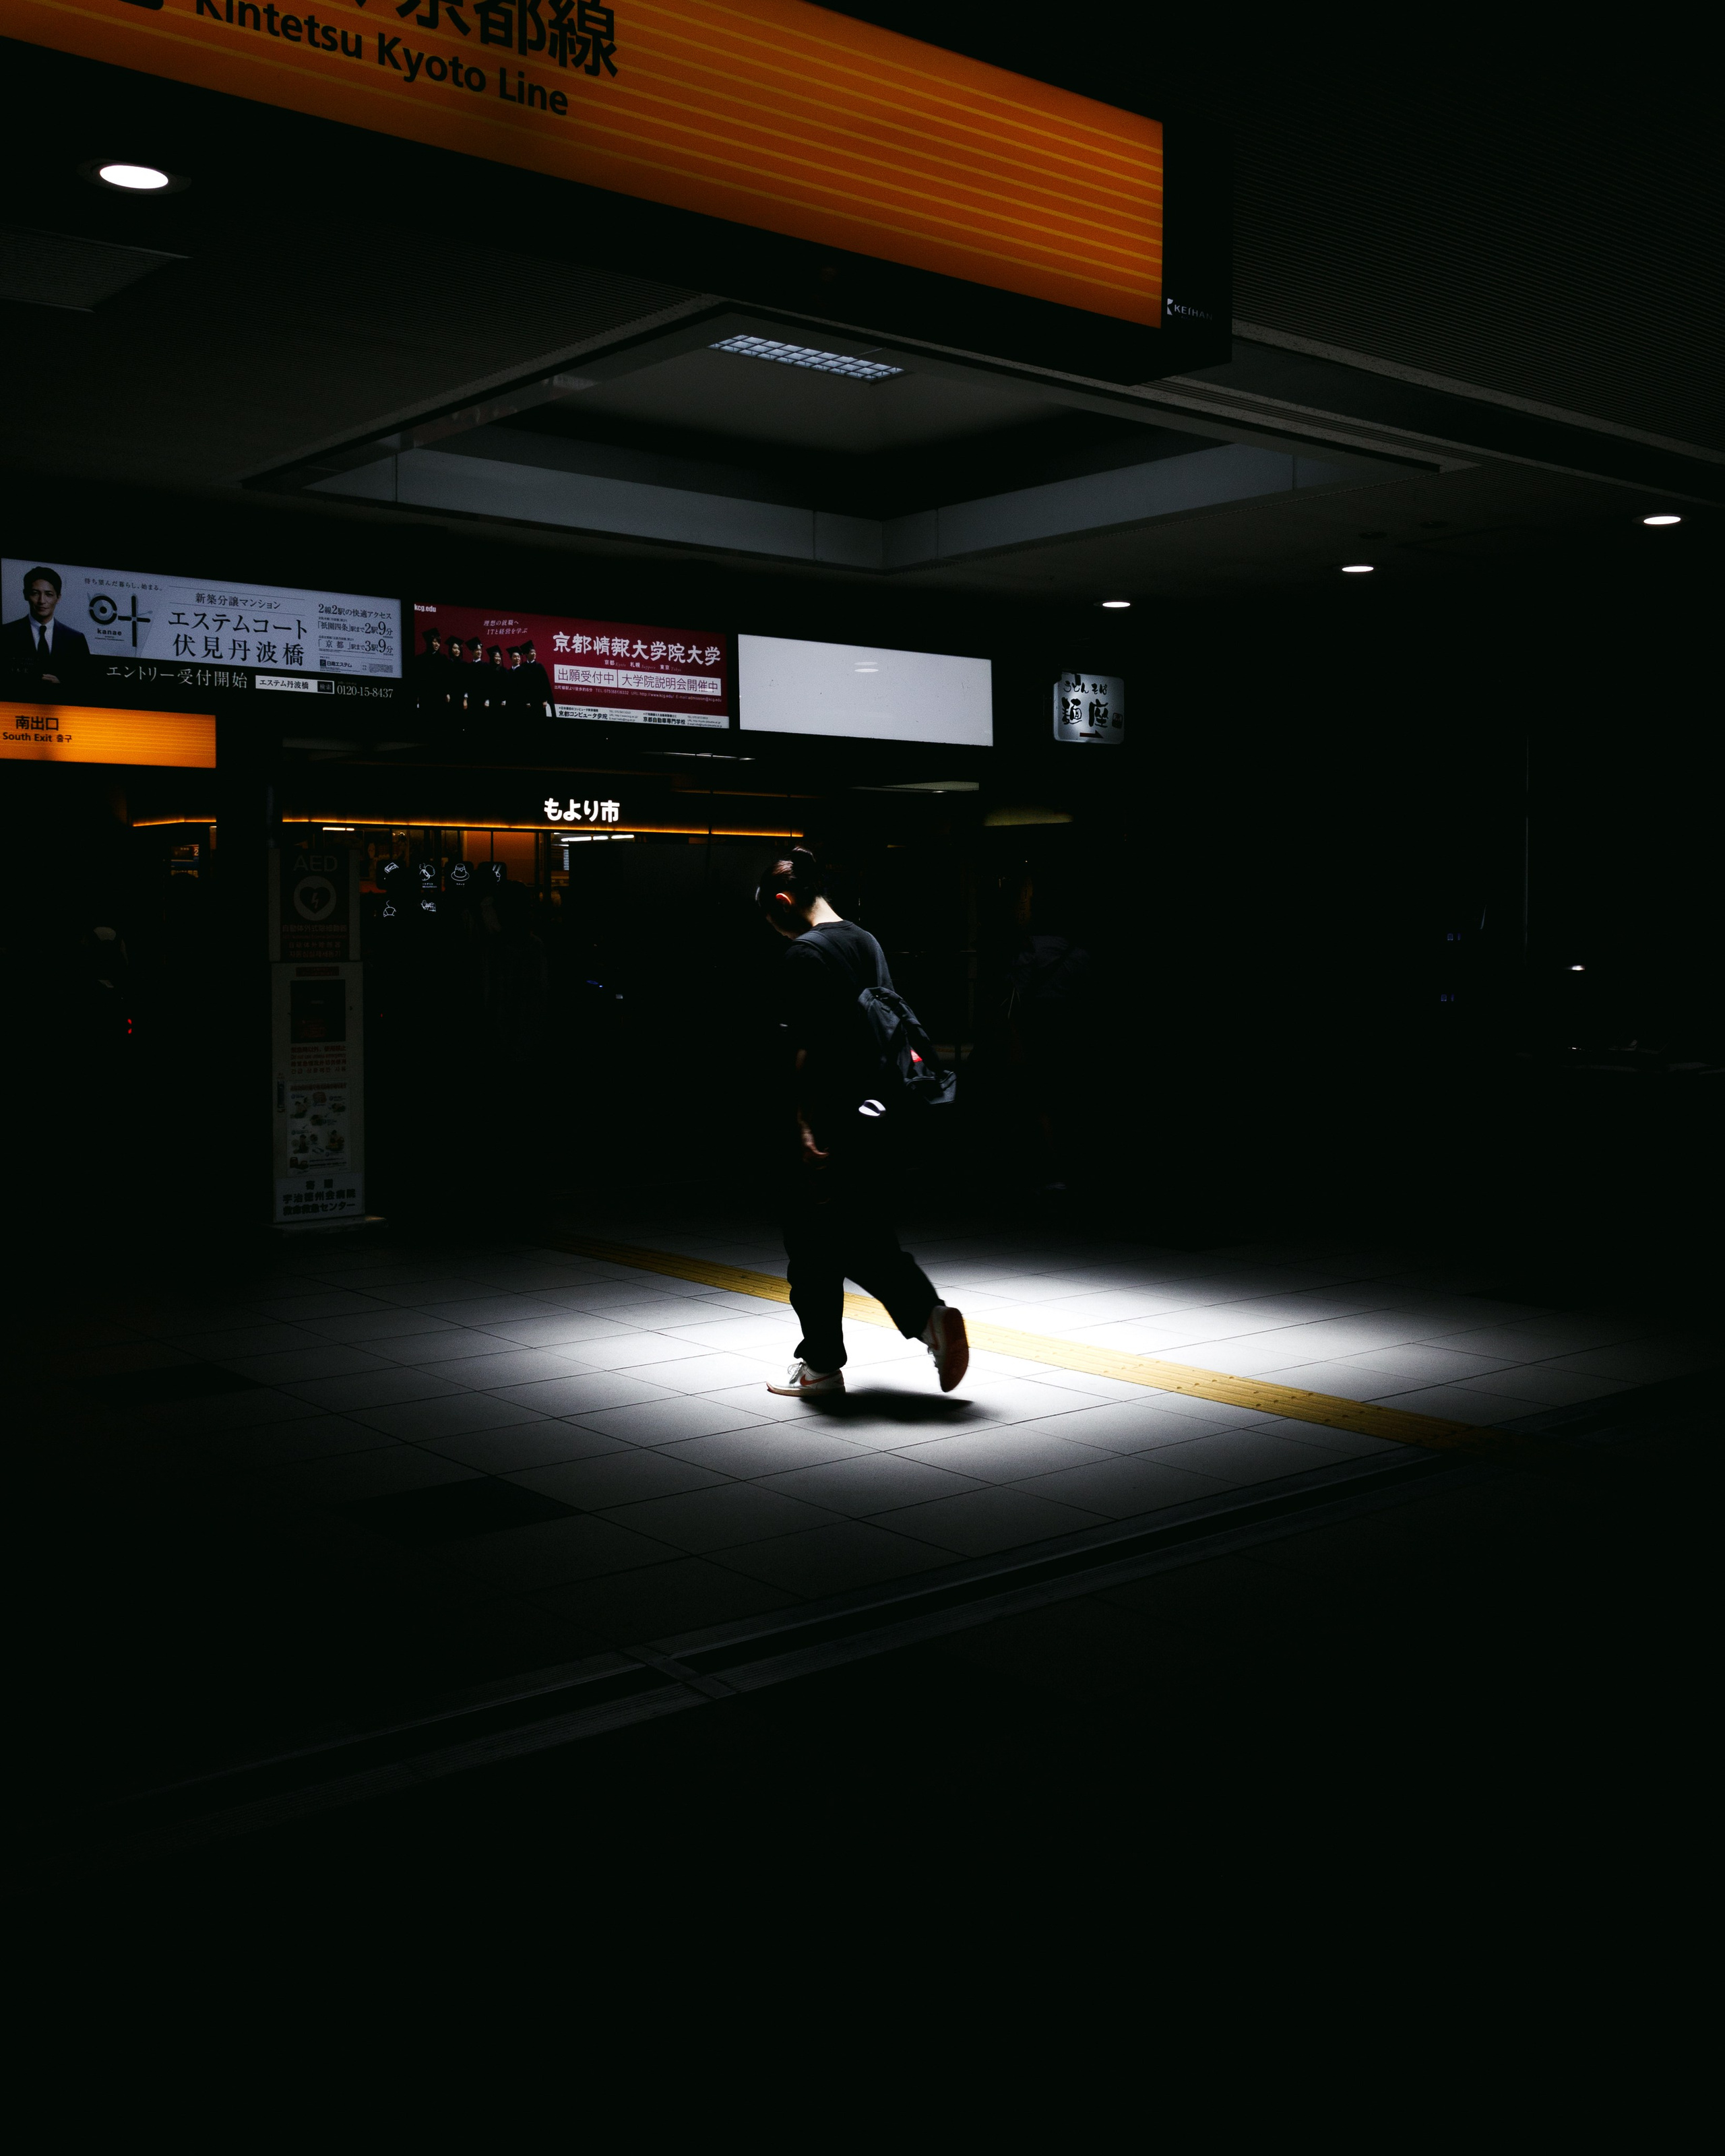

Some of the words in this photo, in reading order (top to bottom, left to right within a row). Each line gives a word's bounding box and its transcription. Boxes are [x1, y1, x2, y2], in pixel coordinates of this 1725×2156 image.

[195, 0, 363, 59] Kintetsu
[377, 32, 487, 92] Kyoto
[499, 67, 569, 115] Line
[1174, 304, 1213, 321] KEIHAN
[195, 592, 281, 610] 新築分譲マンション
[414, 604, 437, 612] kcg.edu
[318, 603, 392, 620] 2線2駅の快適アクセス
[97, 628, 122, 636] kanae
[168, 612, 307, 640] エステムコート
[172, 633, 305, 666] 伏見丹波橋
[553, 631, 721, 666] 京都情報大学院大学
[106, 665, 247, 689] エントリー受付開始
[557, 668, 615, 686] 出願受付中
[621, 674, 719, 693] 大学院説明会開催中
[259, 678, 309, 690] エステム丹波橋
[337, 685, 394, 698] 0120-15-8437
[15, 716, 59, 731] 南出口
[3, 732, 31, 742] South
[34, 733, 53, 742] Exit
[56, 734, 72, 743] 출구
[544, 798, 620, 823] もより市
[292, 854, 338, 872] AED
